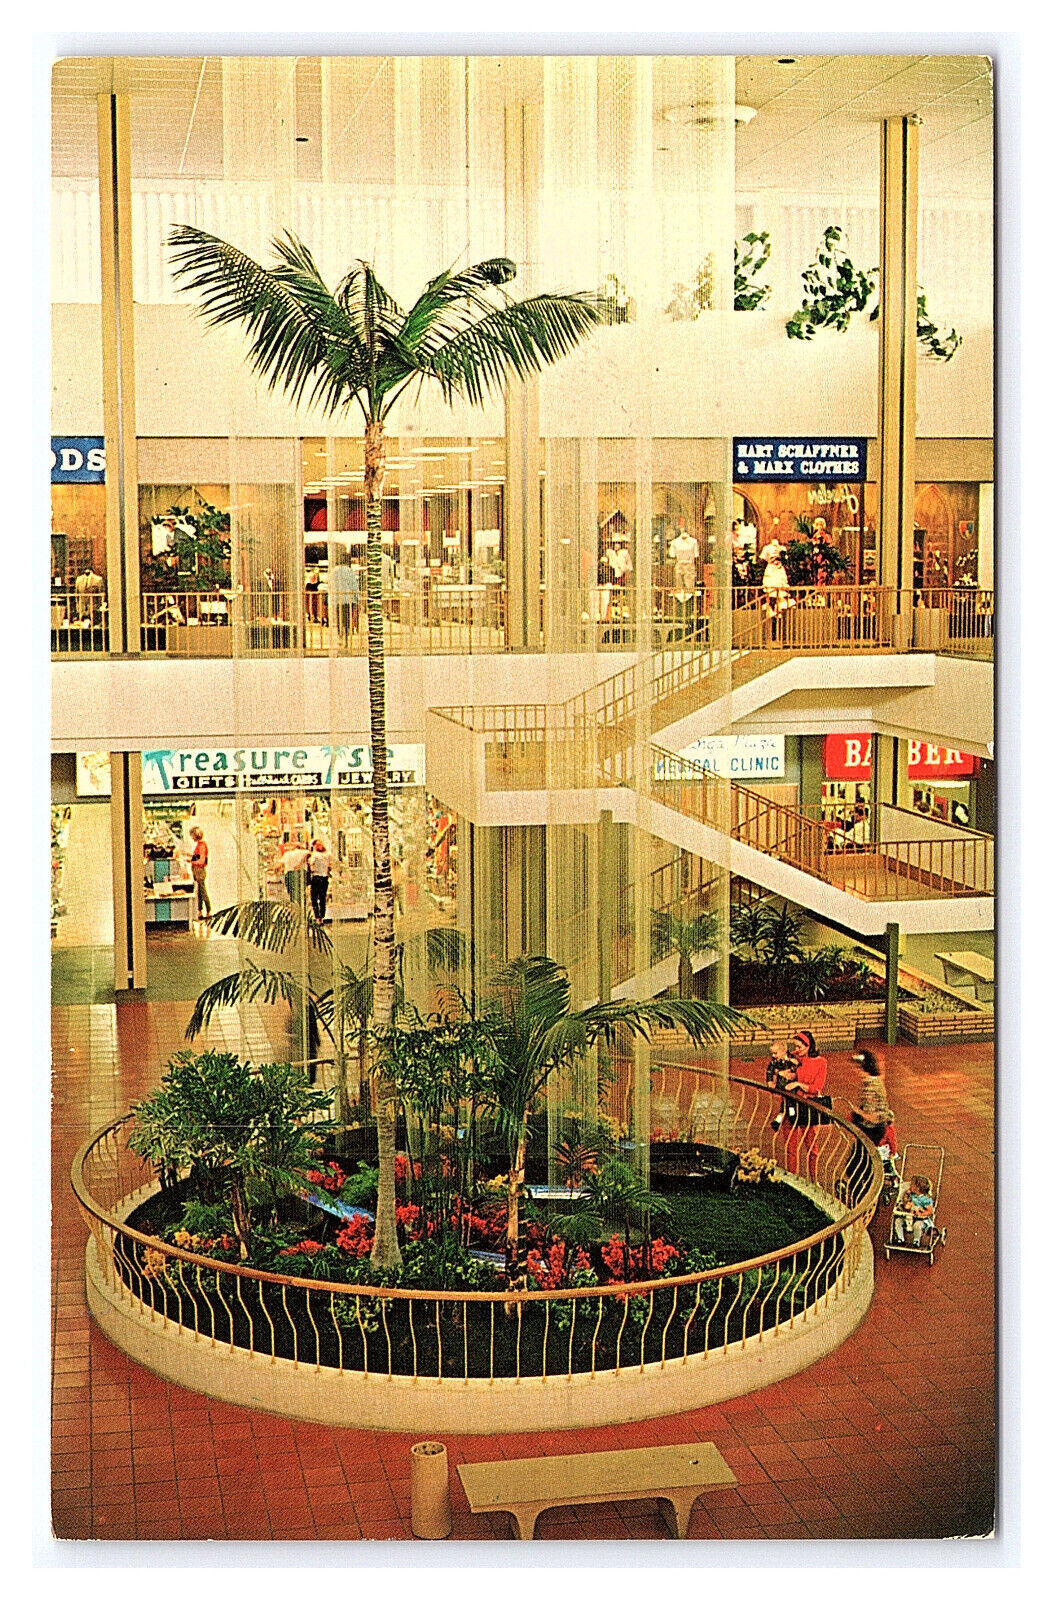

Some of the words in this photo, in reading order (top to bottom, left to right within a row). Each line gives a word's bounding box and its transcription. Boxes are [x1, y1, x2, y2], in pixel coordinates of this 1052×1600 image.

[737, 444, 774, 458] HART
[778, 444, 859, 458] SCHAFFNER
[50, 448, 106, 471] DS
[737, 461, 749, 474] &
[753, 461, 794, 474] MARX
[800, 461, 860, 474] CLOTHES
[844, 739, 963, 767] BABER
[143, 749, 308, 790] Treasure
[730, 756, 780, 772] CLINIC
[176, 776, 237, 788] GIFTS
